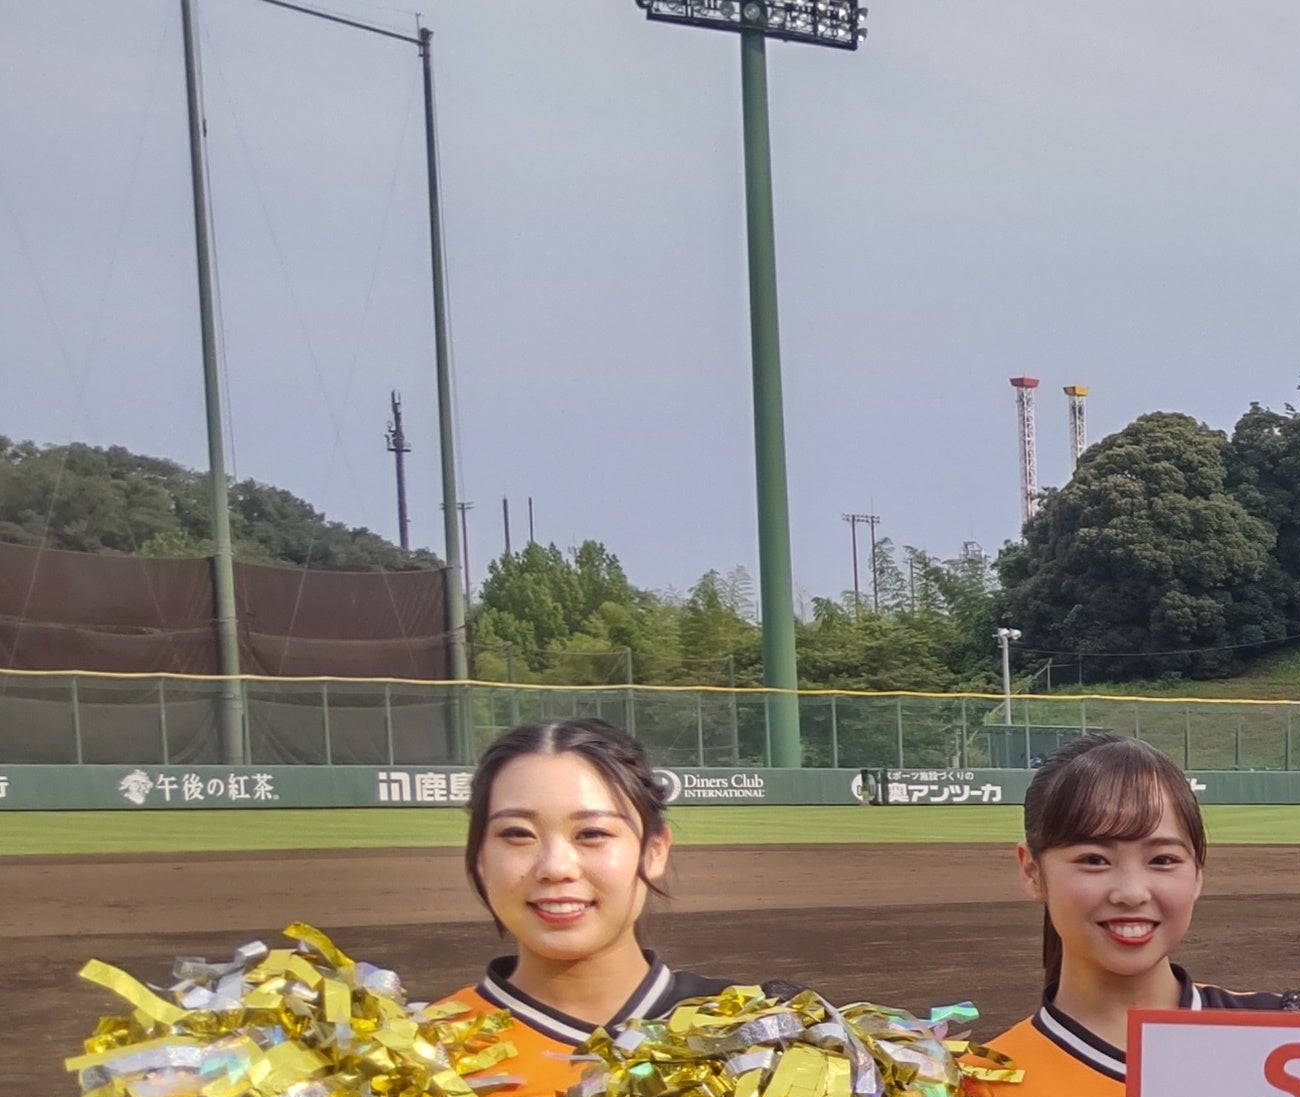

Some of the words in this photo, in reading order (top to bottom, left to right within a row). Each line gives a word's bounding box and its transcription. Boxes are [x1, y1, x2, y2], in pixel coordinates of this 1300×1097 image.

[156, 773, 274, 800] 午後の紅茶
[684, 774, 728, 788] Diners
[731, 774, 764, 788] Club
[684, 789, 765, 797] INTERNATIONAL
